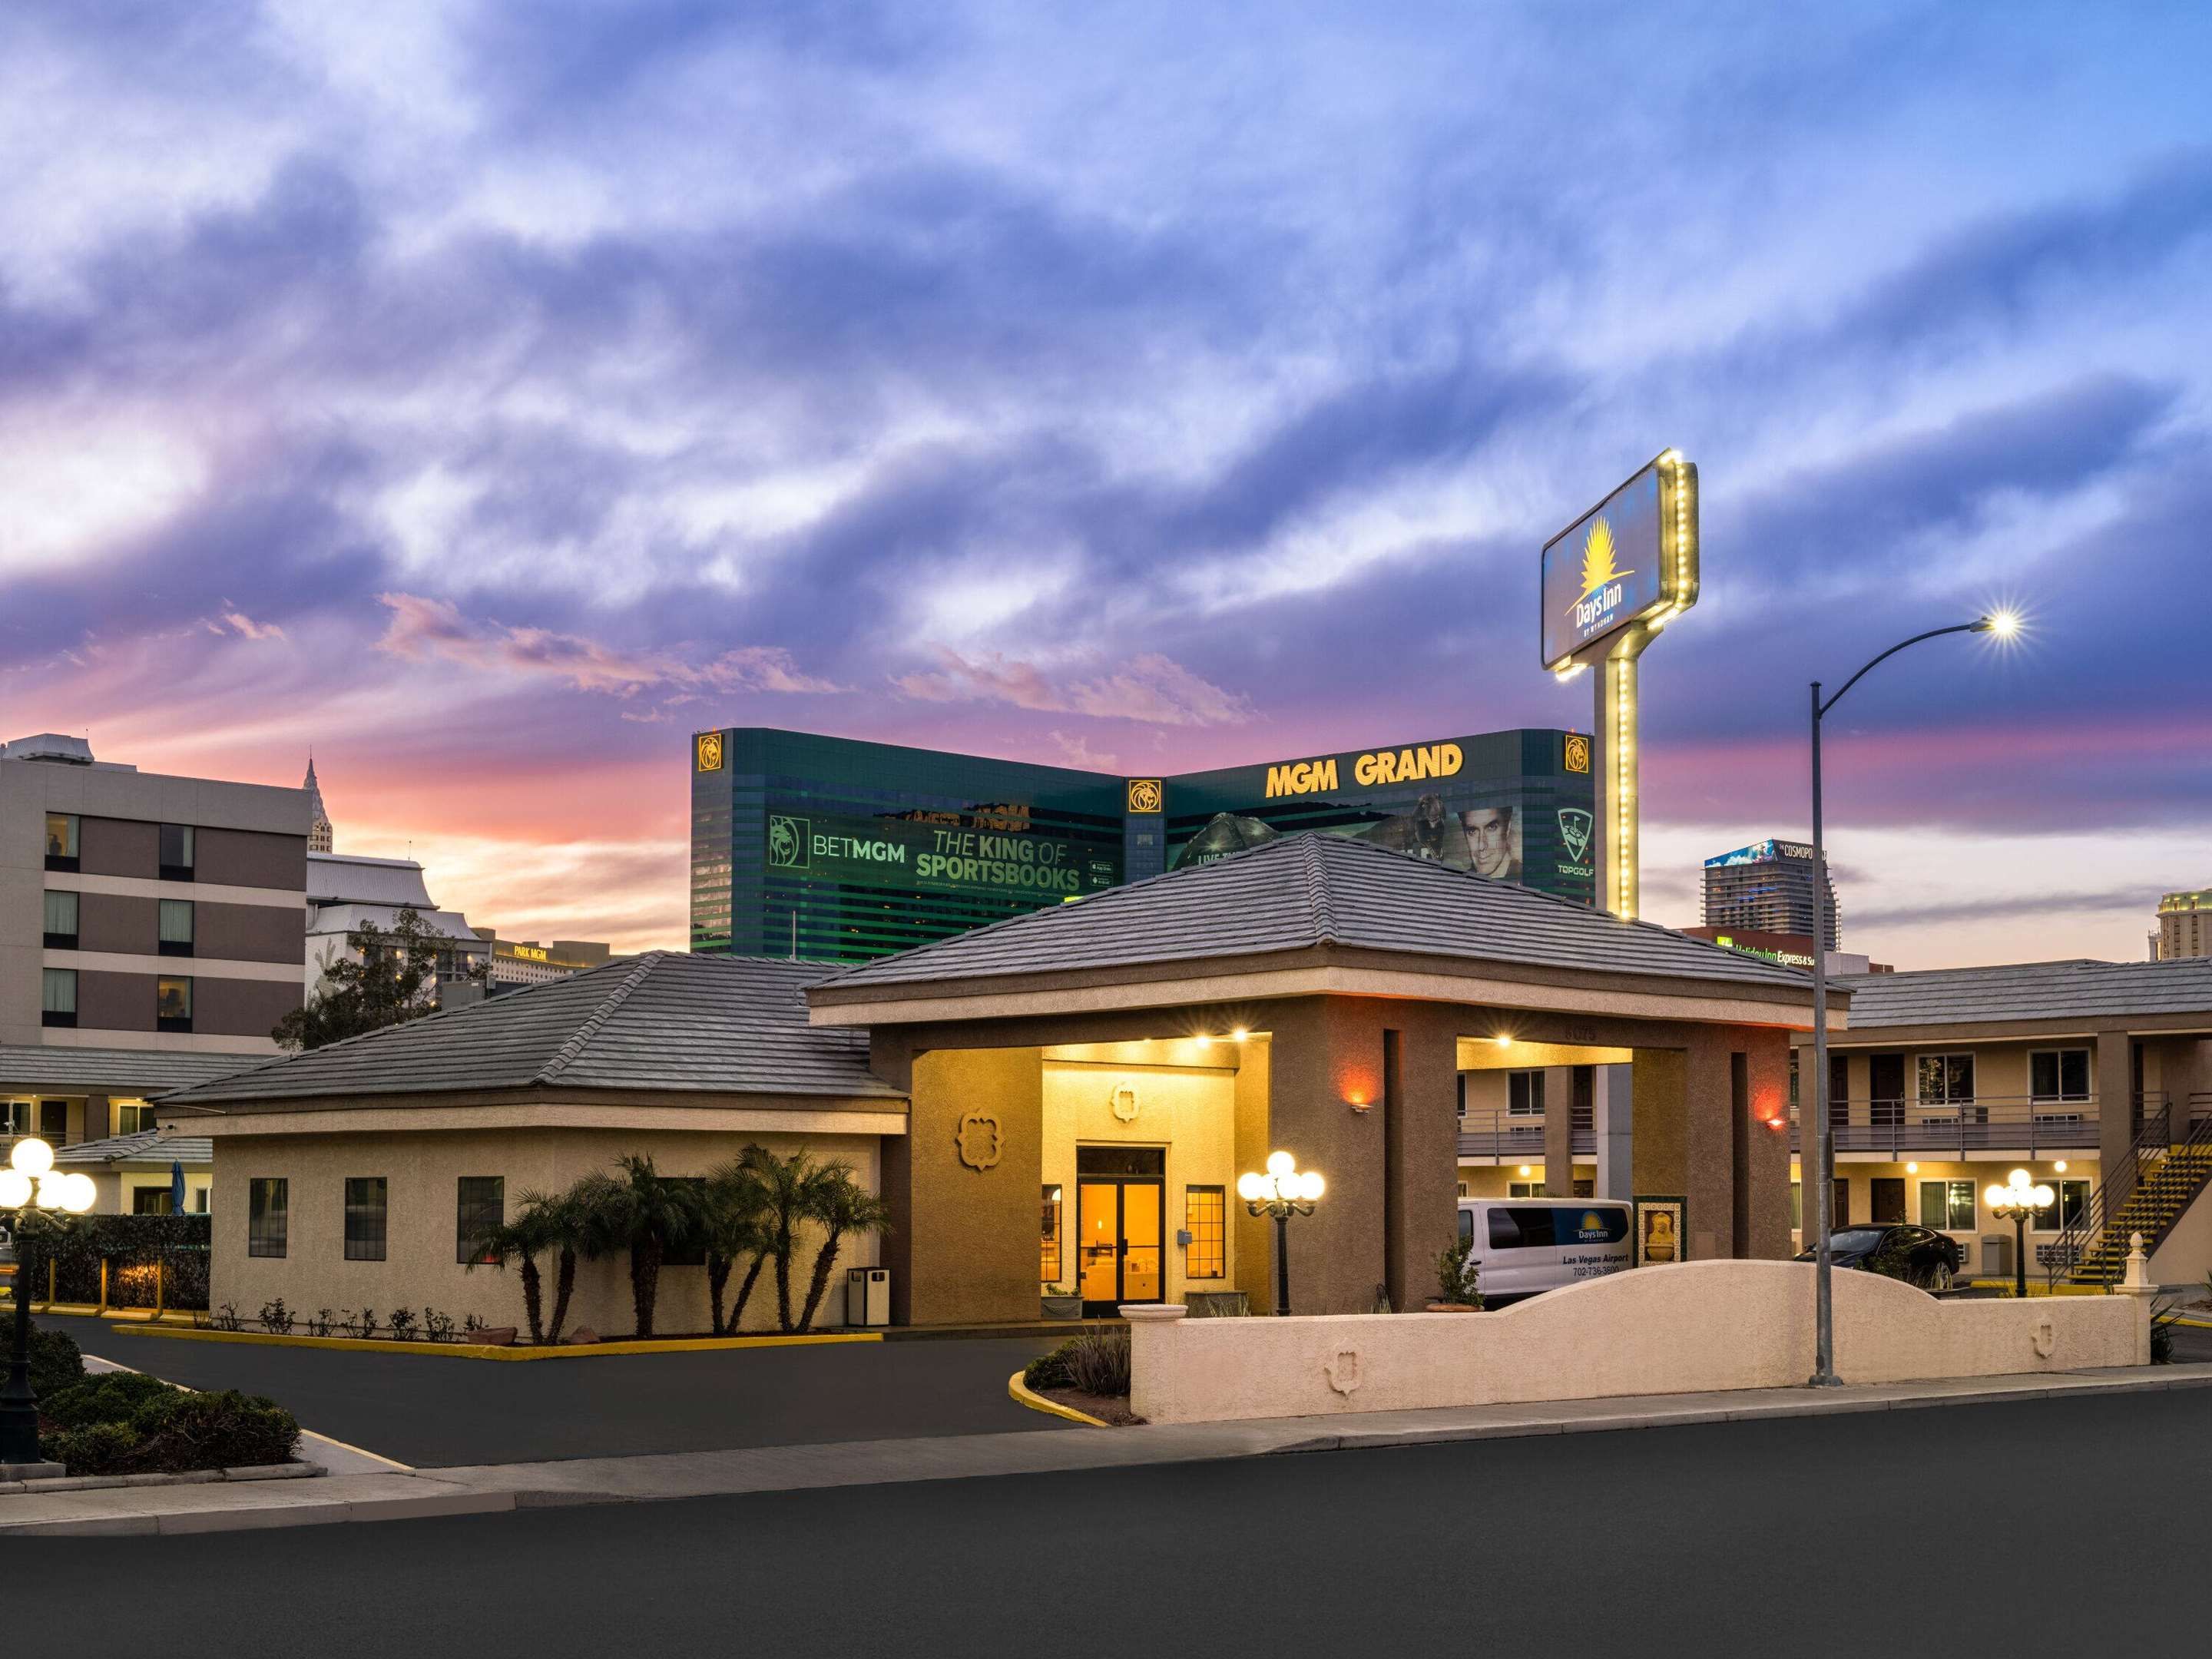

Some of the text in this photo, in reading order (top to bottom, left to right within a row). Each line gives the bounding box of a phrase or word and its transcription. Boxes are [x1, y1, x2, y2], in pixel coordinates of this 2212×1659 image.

[1576, 584, 1621, 629] Days Inn
[1265, 743, 1463, 798] MGM GRAND
[813, 835, 905, 863] BETMGM
[933, 830, 1068, 865] THE KING OF
[916, 853, 1080, 891] SPORTSBOOKS
[1558, 865, 1594, 876] TOPGOLF
[514, 945, 547, 960] PARK MGM
[1777, 950, 1802, 965] Express
[1802, 955, 1807, 965] &
[1578, 1230, 1596, 1240] Days
[1562, 1253, 1629, 1265] Las Vegas Airport
